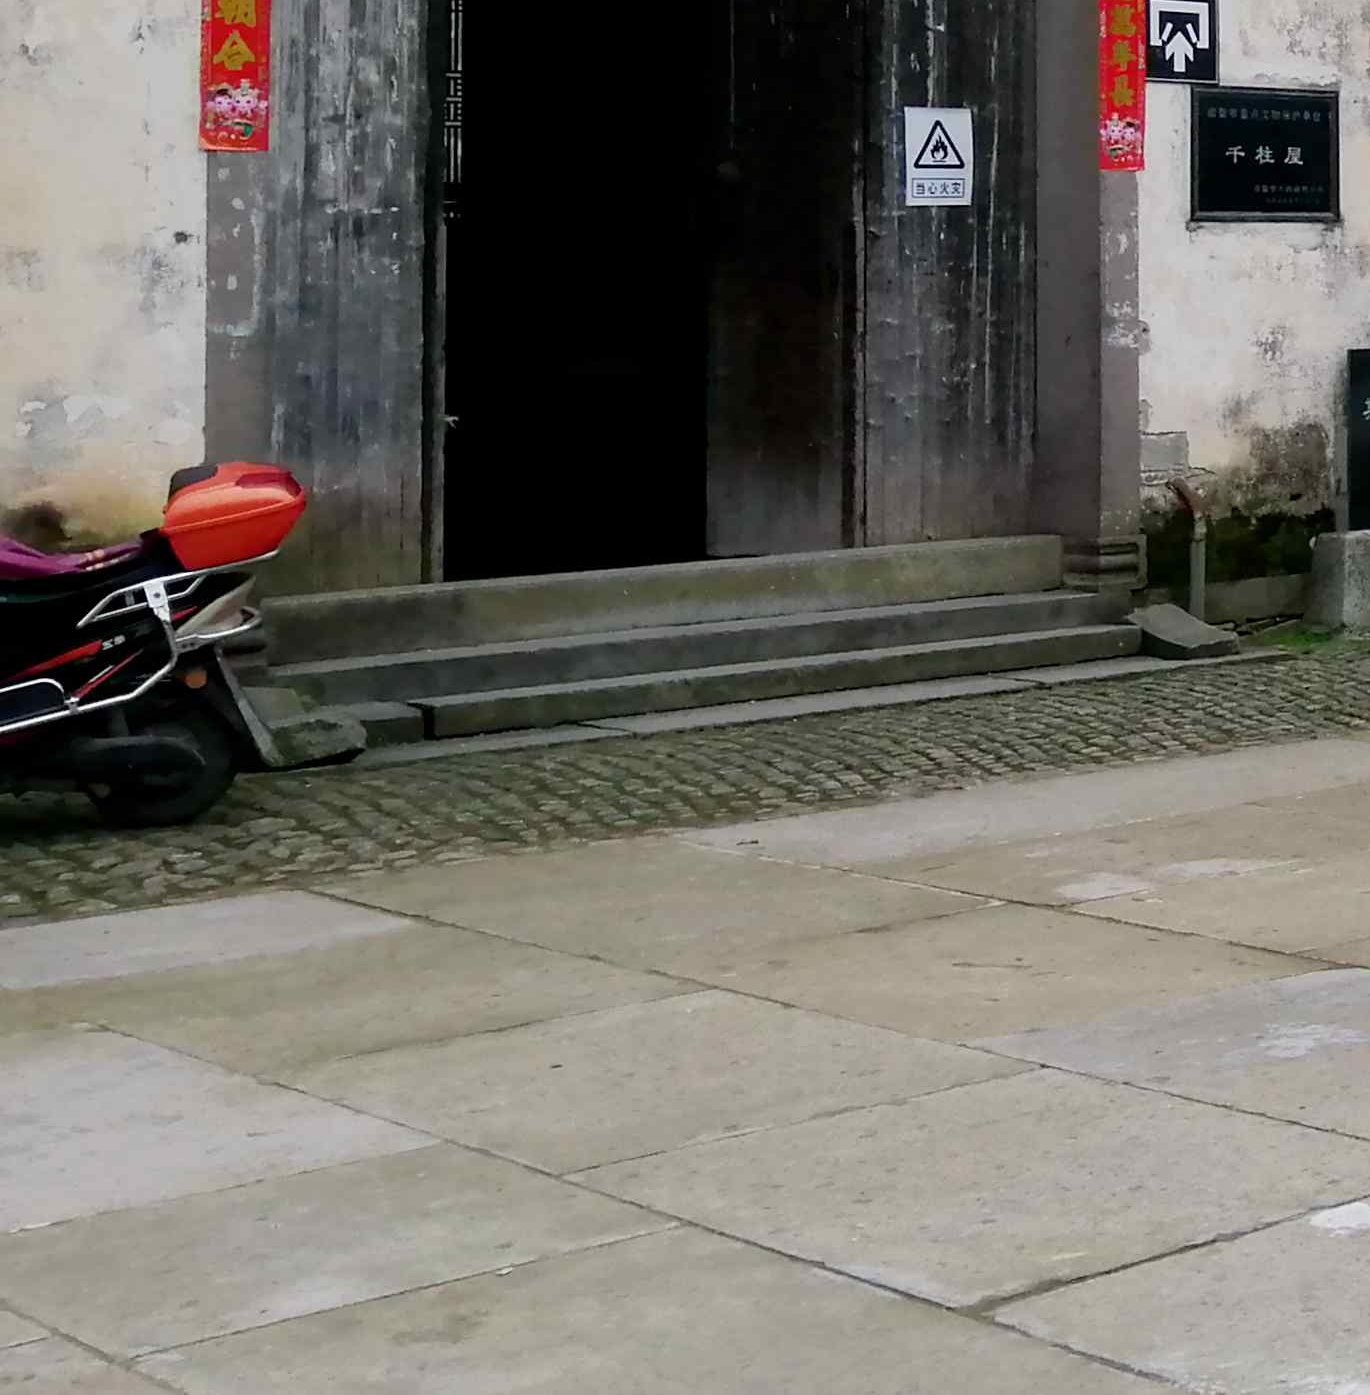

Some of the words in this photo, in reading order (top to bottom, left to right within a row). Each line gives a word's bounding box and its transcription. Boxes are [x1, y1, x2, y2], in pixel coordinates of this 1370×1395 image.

[1225, 145, 1304, 166] 千柱屋
[916, 182, 960, 195] 当心火灾
